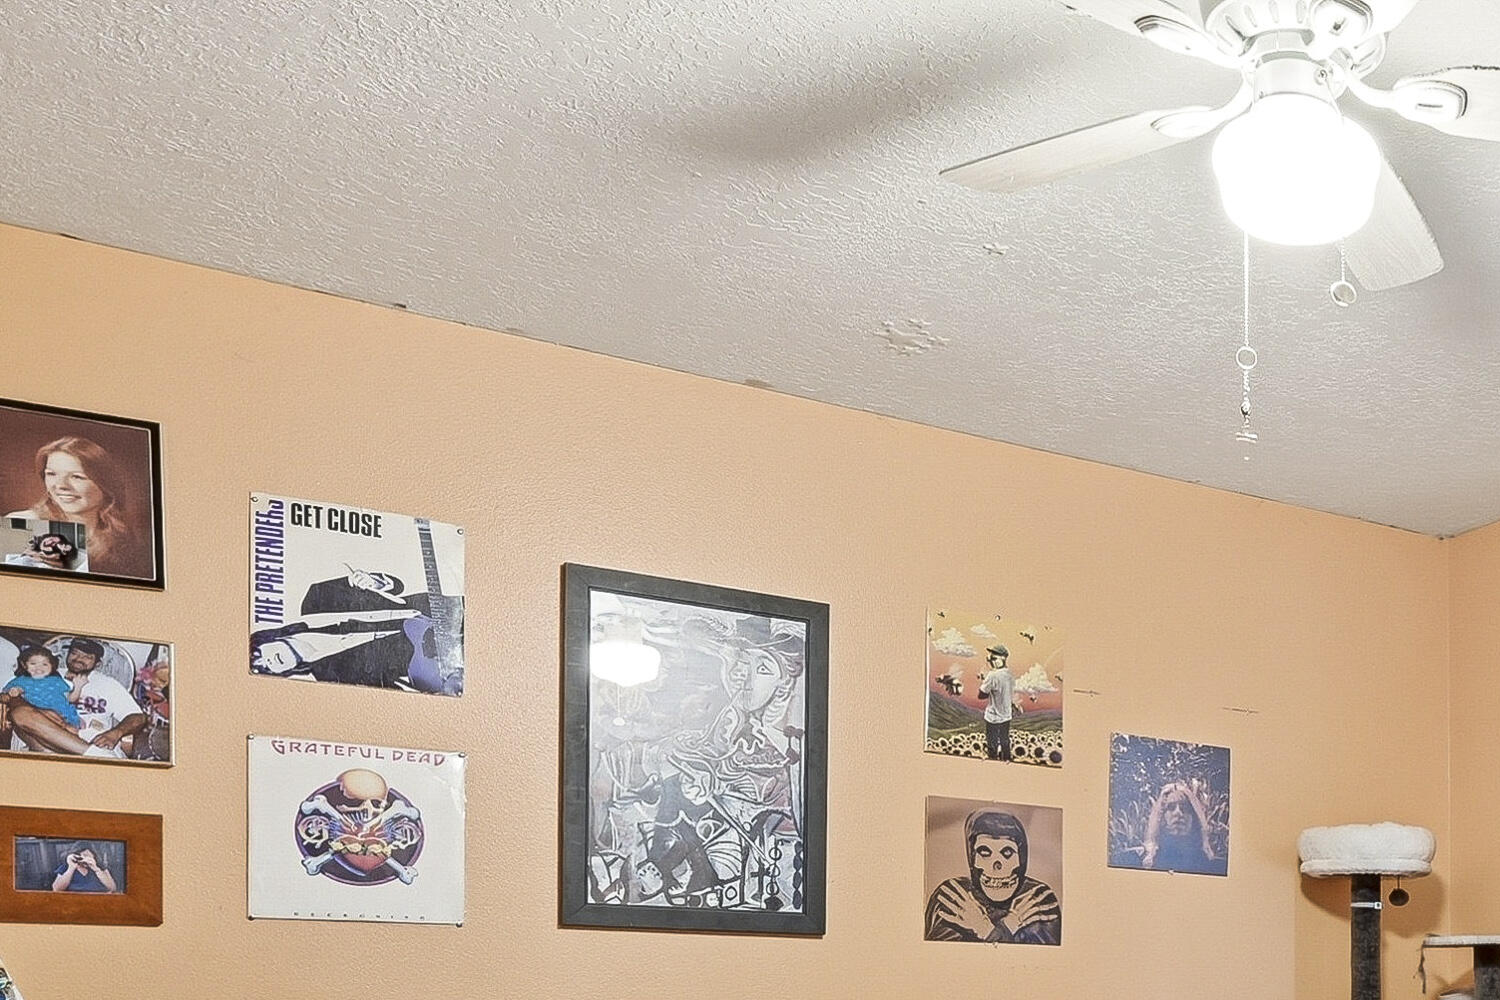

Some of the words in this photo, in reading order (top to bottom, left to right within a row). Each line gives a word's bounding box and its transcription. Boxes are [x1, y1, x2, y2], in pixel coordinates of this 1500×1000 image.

[290, 502, 323, 529] GET
[327, 507, 382, 539] CLOSE
[254, 596, 284, 624] THE
[271, 739, 385, 760] GRATEFUL
[392, 750, 446, 766] DEAD
